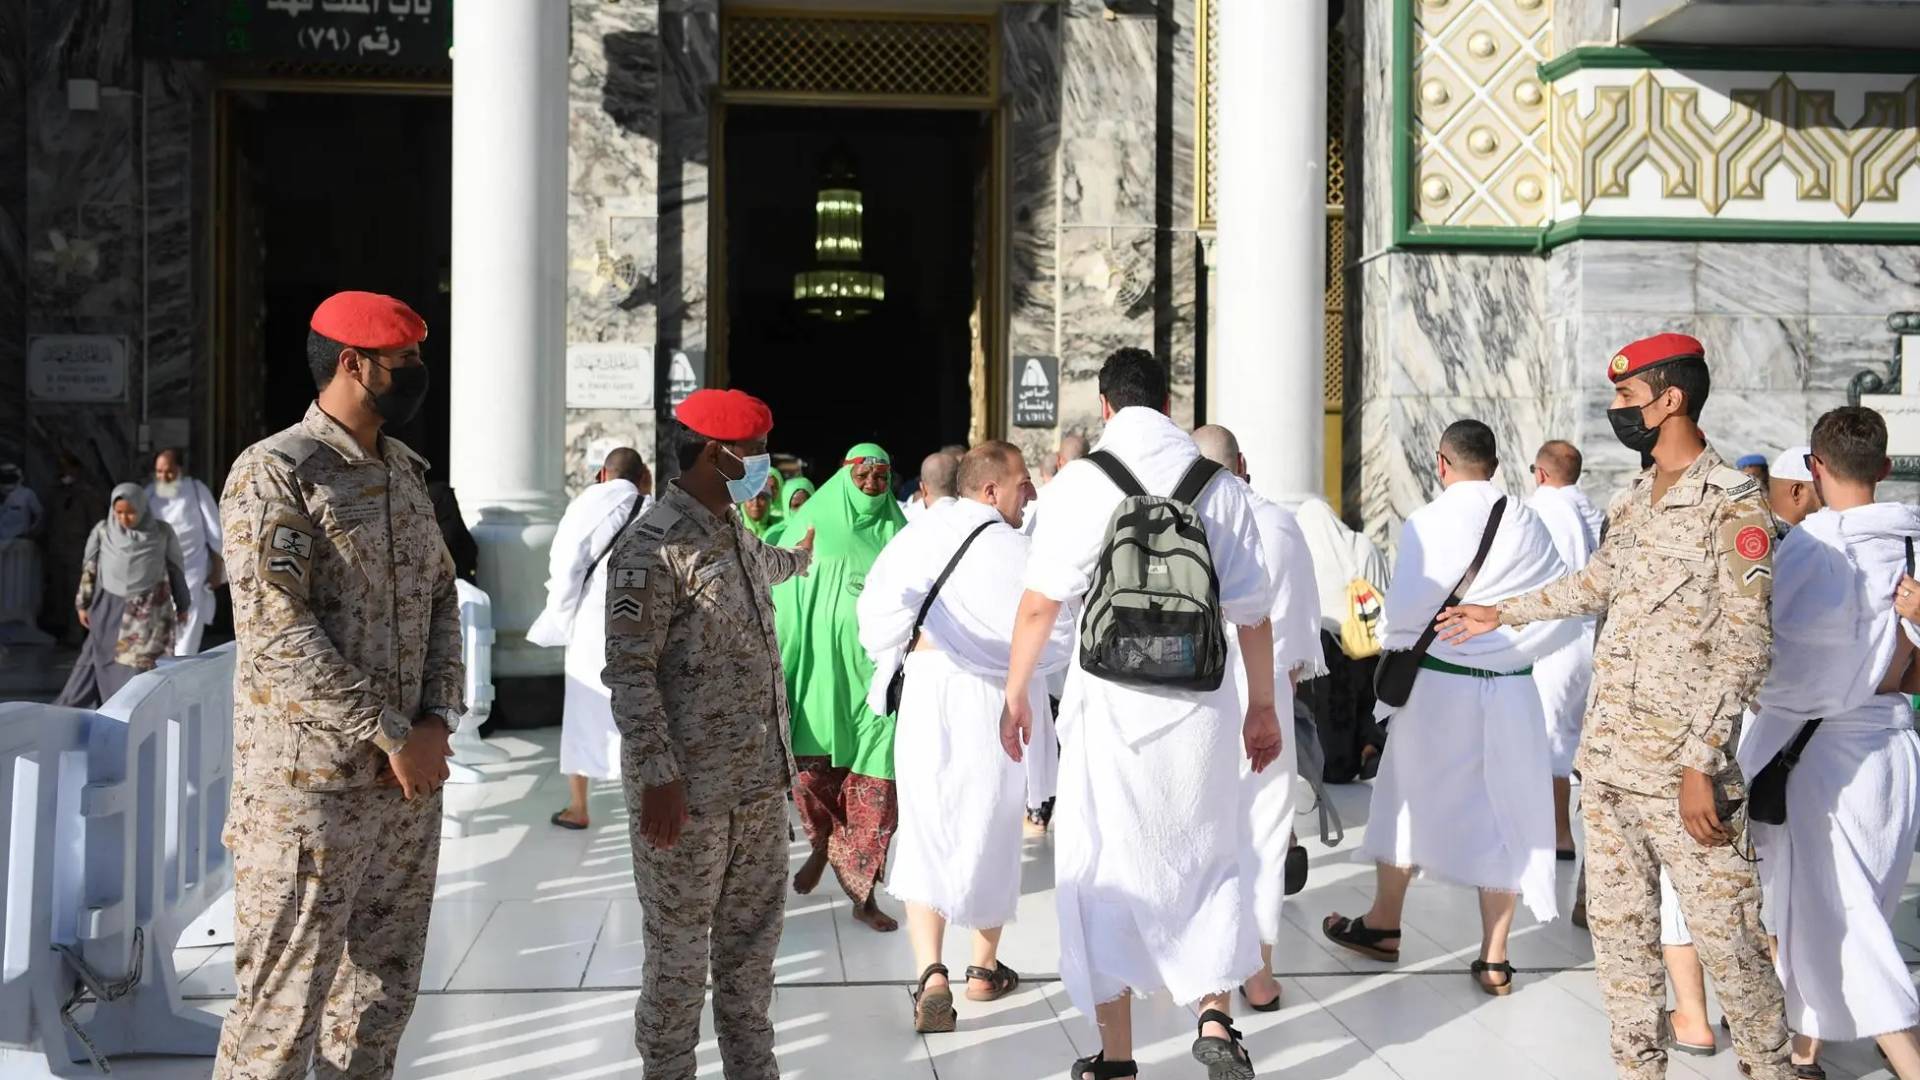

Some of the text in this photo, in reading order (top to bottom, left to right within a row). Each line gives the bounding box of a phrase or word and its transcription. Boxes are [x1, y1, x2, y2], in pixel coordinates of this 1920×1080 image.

[357, 25, 401, 56] رقم
[1019, 386, 1050, 400] خاص
[1018, 399, 1054, 413] بالنساء
